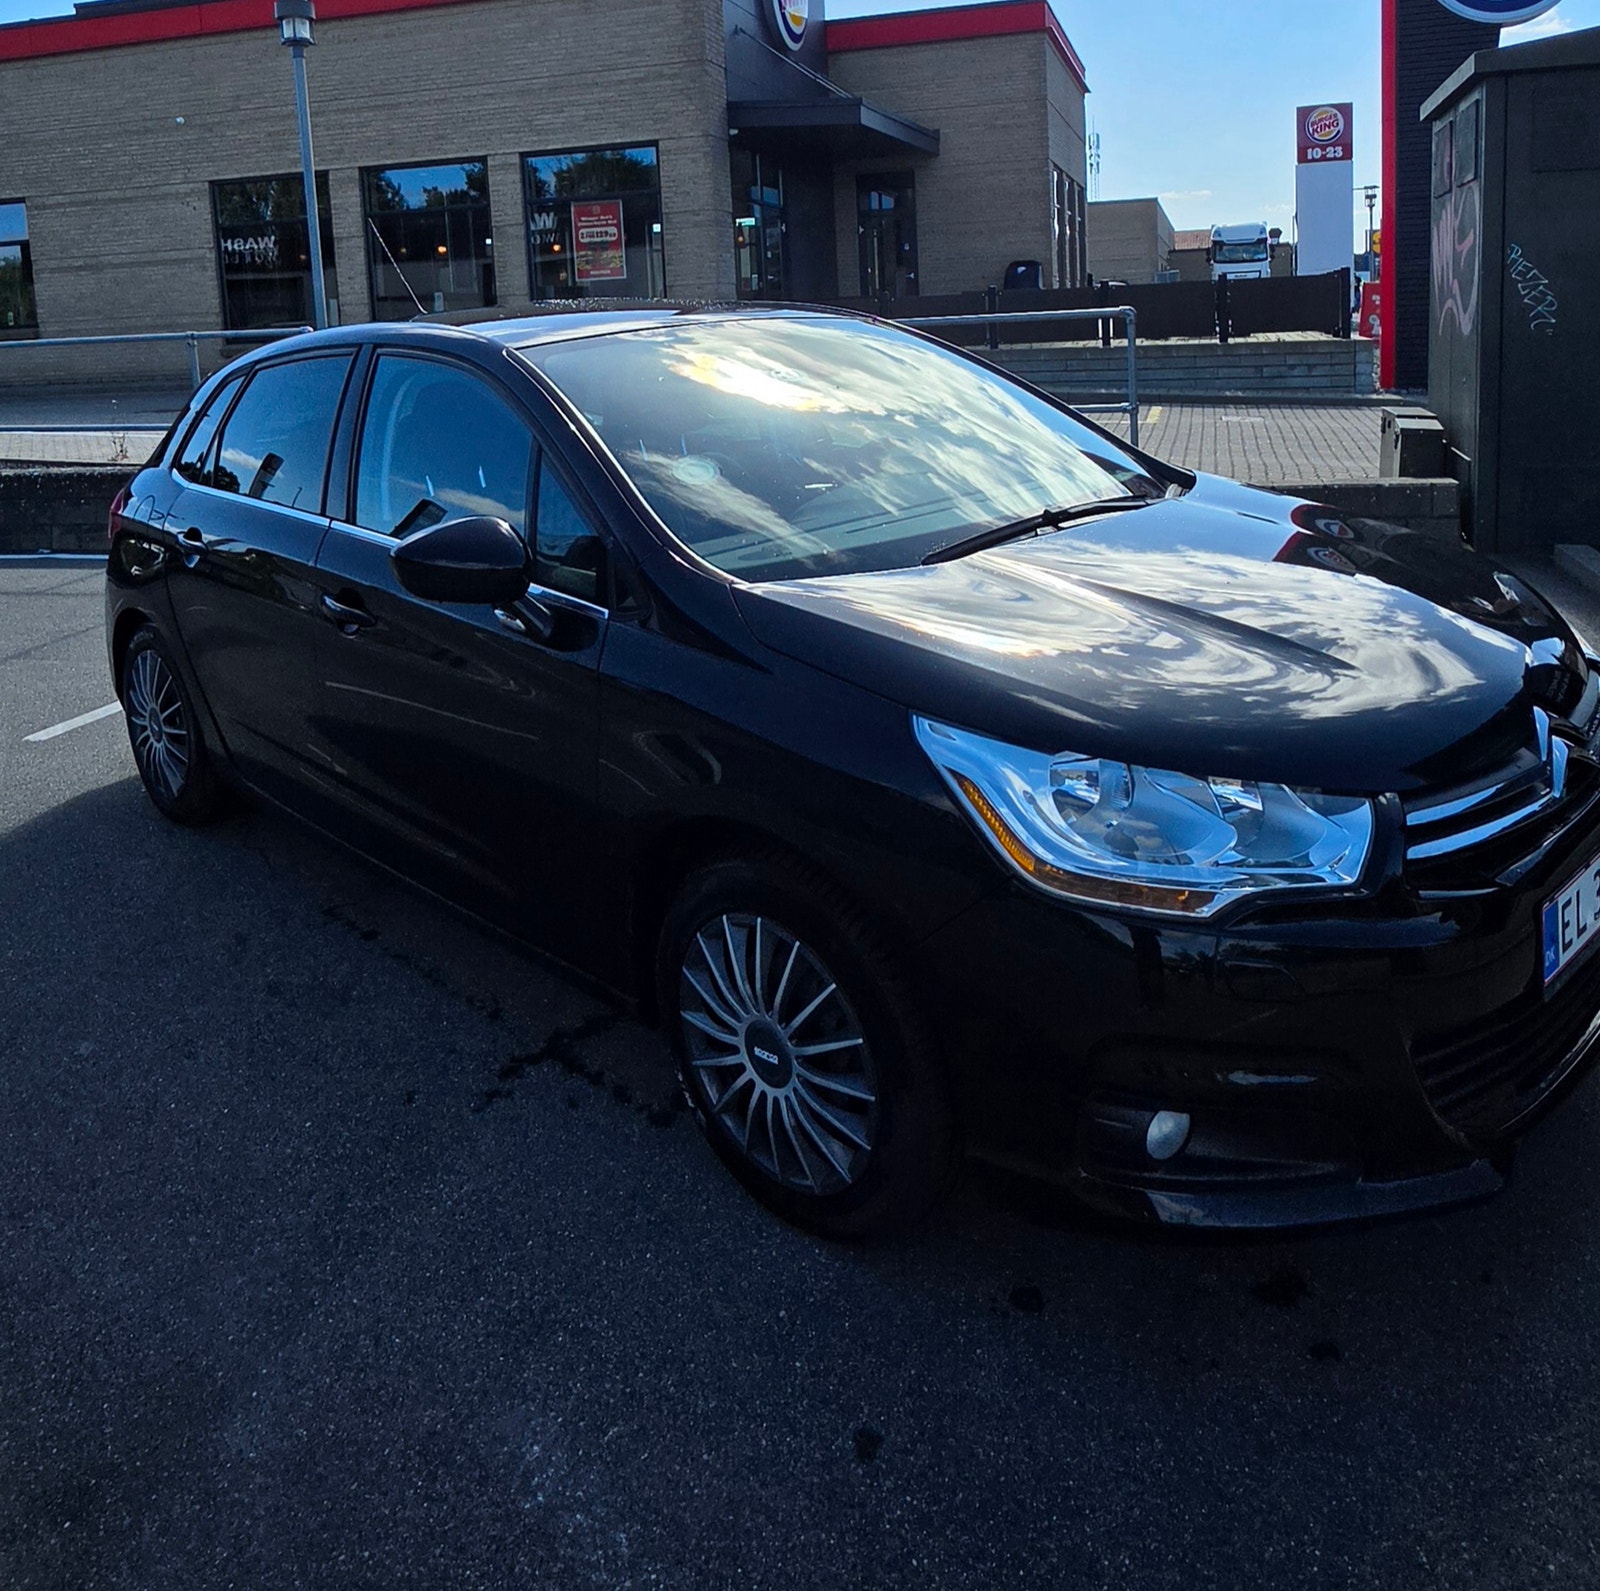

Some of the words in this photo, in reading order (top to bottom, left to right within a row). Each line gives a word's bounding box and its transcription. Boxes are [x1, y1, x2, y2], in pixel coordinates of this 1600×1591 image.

[1311, 113, 1337, 128] BURGER
[1311, 120, 1339, 136] KING
[1307, 146, 1343, 160] 10-23
[1562, 889, 1588, 954] EL
[1545, 946, 1556, 968] DK
